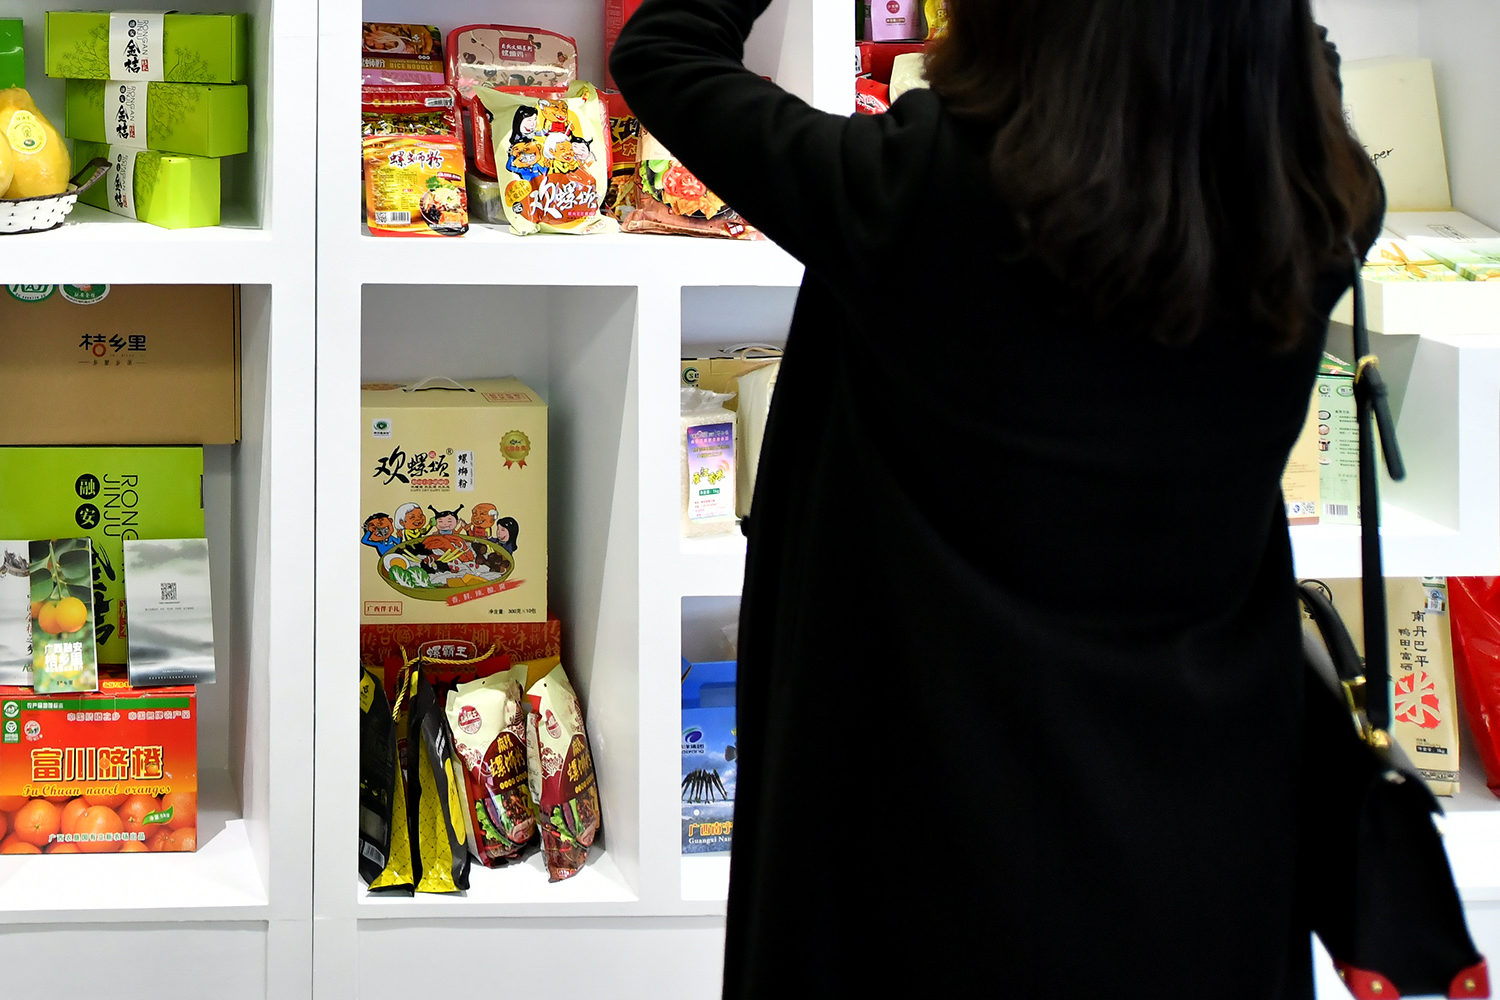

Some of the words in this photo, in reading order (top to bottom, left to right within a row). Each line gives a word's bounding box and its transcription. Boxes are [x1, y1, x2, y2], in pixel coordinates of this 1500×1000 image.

[122, 39, 141, 74] 金桔
[389, 62, 405, 70] RICE
[406, 63, 434, 71] NOODLE
[115, 104, 130, 140] 金桔
[387, 149, 445, 170] 螺蛳粉
[78, 333, 147, 358] 桔乡里
[457, 453, 470, 489] 螺蛳粉
[79, 479, 96, 527] 融安
[102, 473, 121, 537] JINJU
[367, 604, 401, 614] 广西伴手礼
[43, 641, 83, 656] 广西融安
[1411, 610, 1430, 668] 南丹巴平
[426, 644, 468, 660] 螺霸王
[1395, 670, 1442, 726] 米
[29, 745, 165, 783] 富川脐橙
[85, 784, 120, 796] navel
[123, 784, 172, 799] oranges
[688, 821, 733, 837] 广西南宁
[688, 836, 717, 845] Guangxi
